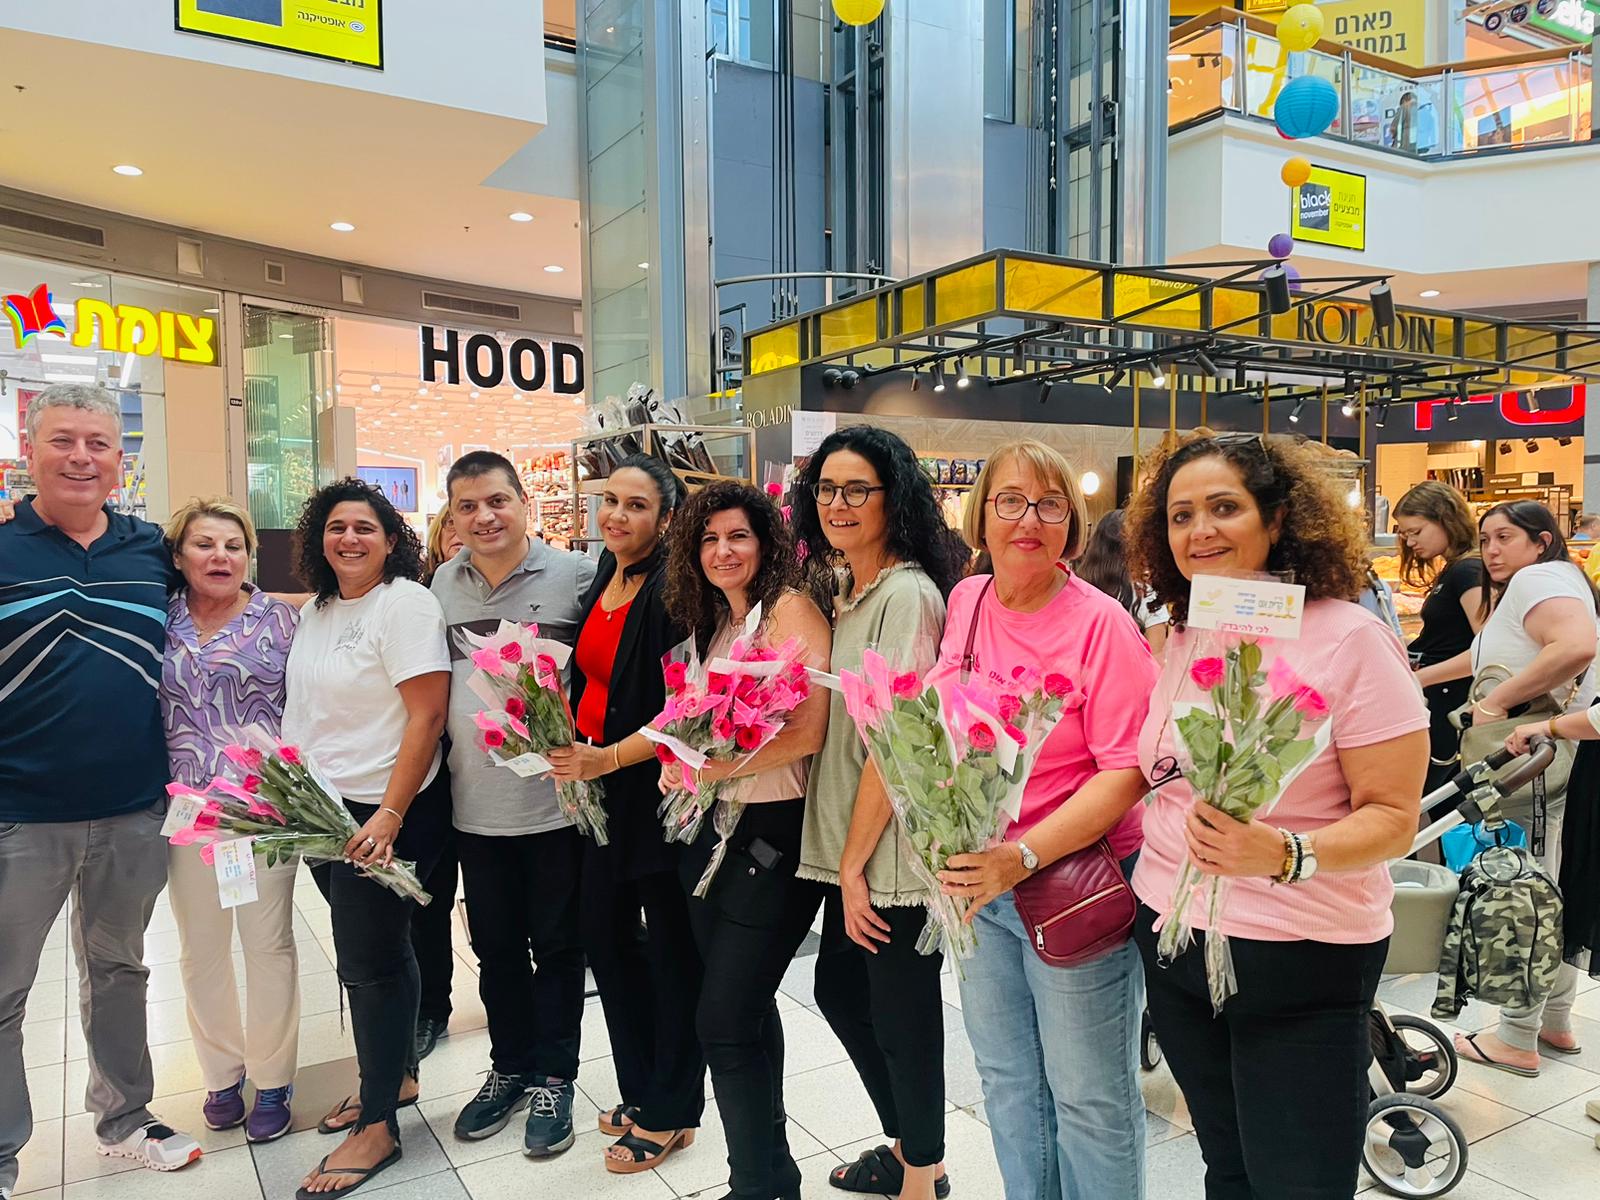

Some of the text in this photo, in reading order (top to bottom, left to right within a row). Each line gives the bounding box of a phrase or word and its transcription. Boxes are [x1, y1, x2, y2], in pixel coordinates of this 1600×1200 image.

[297, 10, 346, 28] אופטיקנה
[1335, 10, 1392, 35] פארם
[1300, 190, 1331, 209] black
[1333, 203, 1360, 217] מבצעים
[1300, 209, 1329, 220] november
[71, 297, 214, 364] צומת
[1296, 302, 1437, 354] ROLADIN
[419, 325, 585, 395] HOOD
[746, 403, 795, 430] ROLADIN
